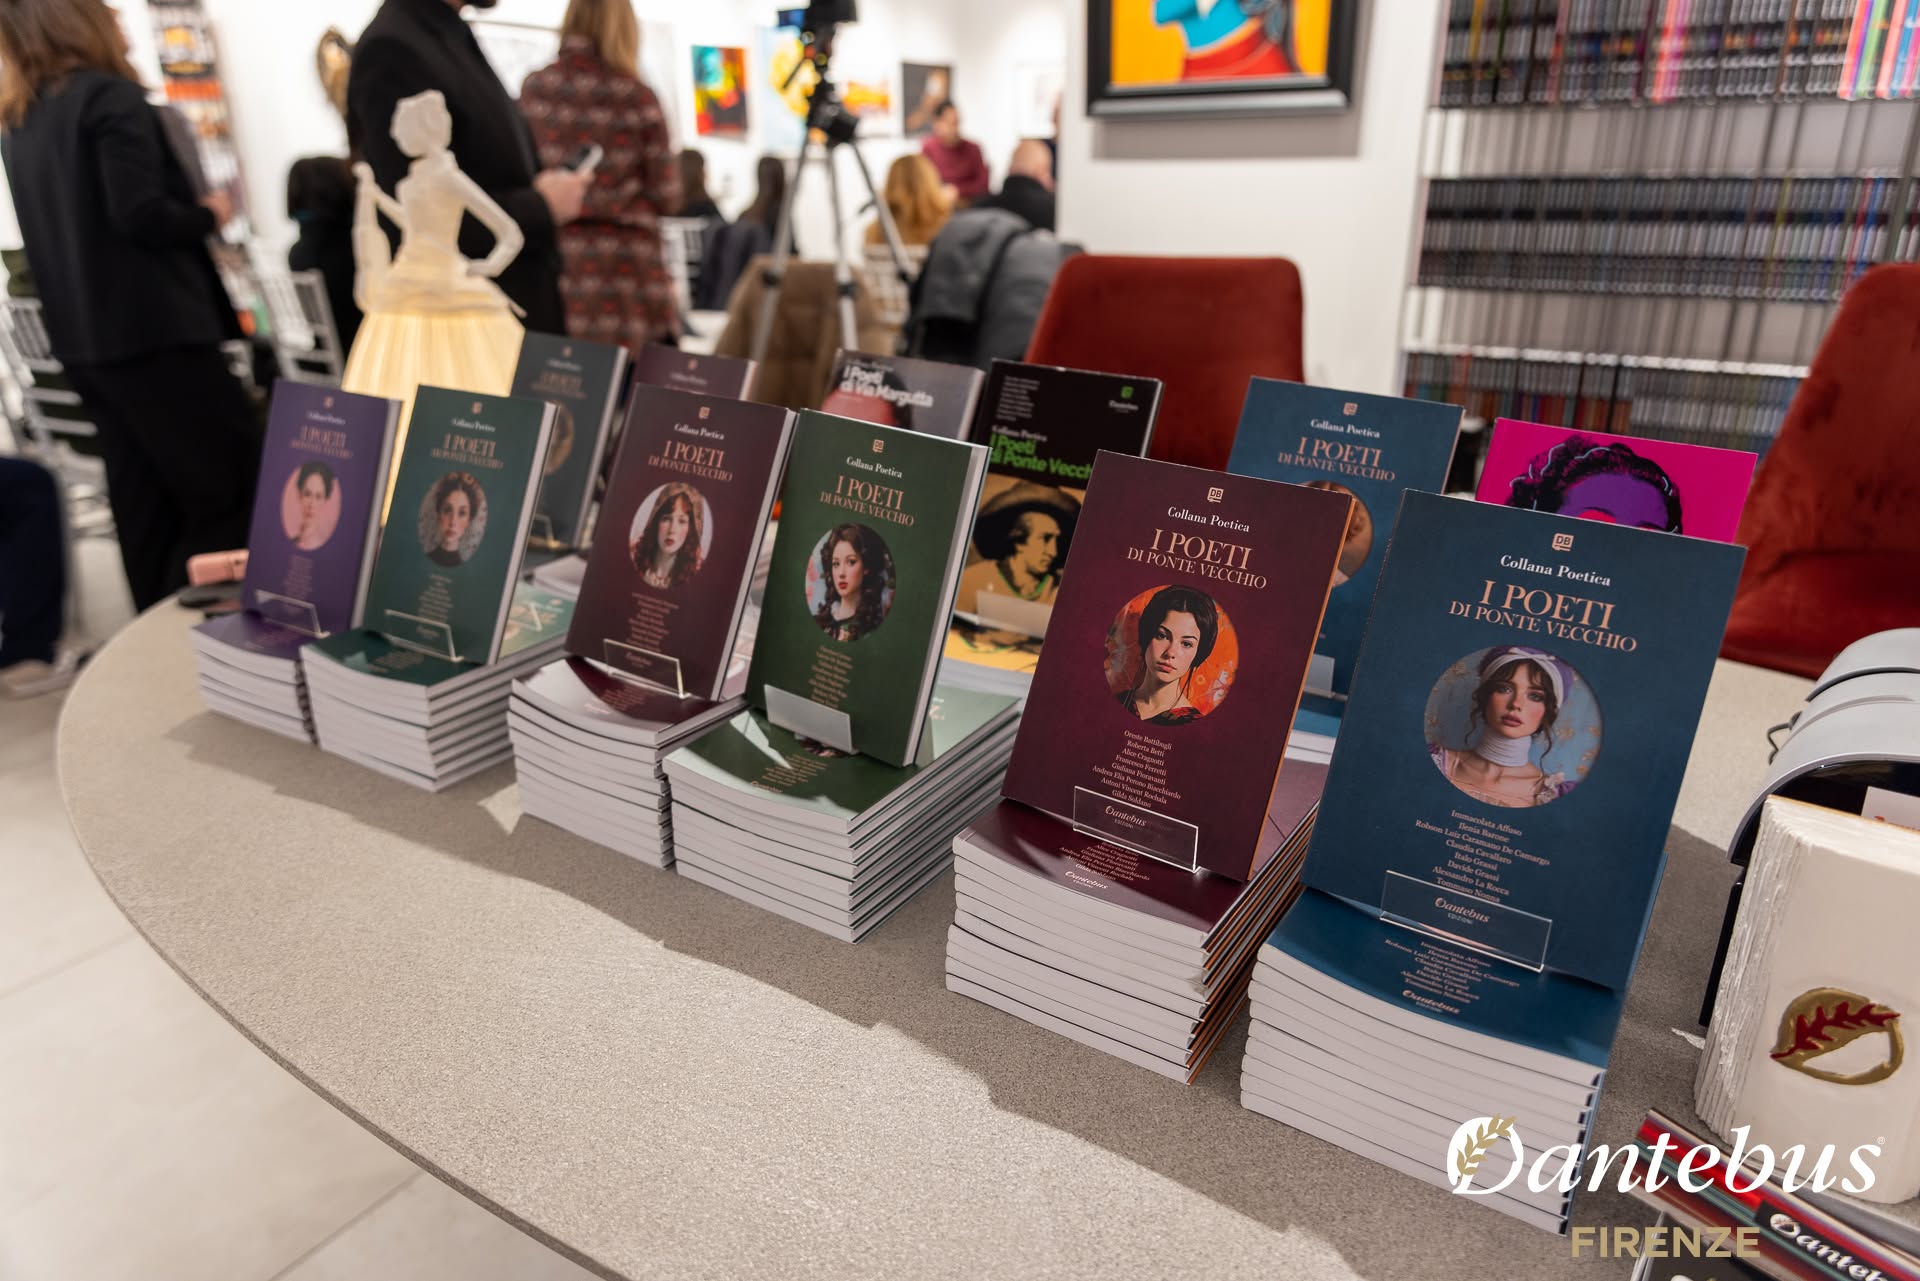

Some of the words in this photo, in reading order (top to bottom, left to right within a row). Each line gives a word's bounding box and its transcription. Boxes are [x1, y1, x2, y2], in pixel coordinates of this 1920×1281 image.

[852, 366, 884, 384] Poeti
[876, 385, 934, 407] Margutta
[1310, 419, 1344, 433] Collana
[1346, 424, 1380, 438] Poetica
[453, 434, 496, 457] POETI
[663, 440, 672, 457] I
[674, 441, 725, 468] POETI
[1000, 434, 1036, 455] Poeti
[1298, 437, 1308, 454] I
[1311, 439, 1383, 467] POETI
[659, 458, 691, 475] PONTE
[692, 465, 733, 481] VECCHIO
[846, 456, 874, 472] Collana
[875, 463, 903, 478] Poetica
[1004, 450, 1047, 471] Ponte
[1278, 452, 1292, 464] DI
[1294, 454, 1336, 473] PONTE
[1339, 462, 1396, 482] VECCHIO
[836, 475, 844, 494] I
[847, 478, 904, 510] POETI
[820, 491, 832, 504] DI
[832, 495, 867, 514] PONTE
[868, 505, 914, 526] VECCHIO
[1168, 506, 1207, 525] Collana
[1210, 514, 1250, 533] Poetica
[1150, 528, 1163, 550] I
[1168, 532, 1253, 570] POETI
[1127, 547, 1143, 563] DI
[1145, 551, 1196, 574] PONTE
[1200, 564, 1267, 589] VECCHIO
[1500, 554, 1553, 577] Collana
[1557, 564, 1611, 587] Poetica
[1478, 580, 1497, 605] I
[1501, 583, 1616, 630] POETI
[1449, 600, 1471, 618] DI
[1475, 606, 1540, 633] PONTE
[1547, 621, 1637, 653] VECCHIO
[1122, 748, 1137, 757] Alice
[1127, 740, 1150, 752] Roberta
[1150, 748, 1165, 757] Betti
[1116, 755, 1144, 768] Francesco
[1451, 810, 1496, 828] Immacolata
[1497, 824, 1522, 836] Affuso
[1416, 820, 1443, 834] Robson
[1502, 845, 1514, 854] De
[1446, 839, 1474, 853] Claudia
[1432, 866, 1474, 884] Alessandro
[1448, 860, 1474, 874] Davide
